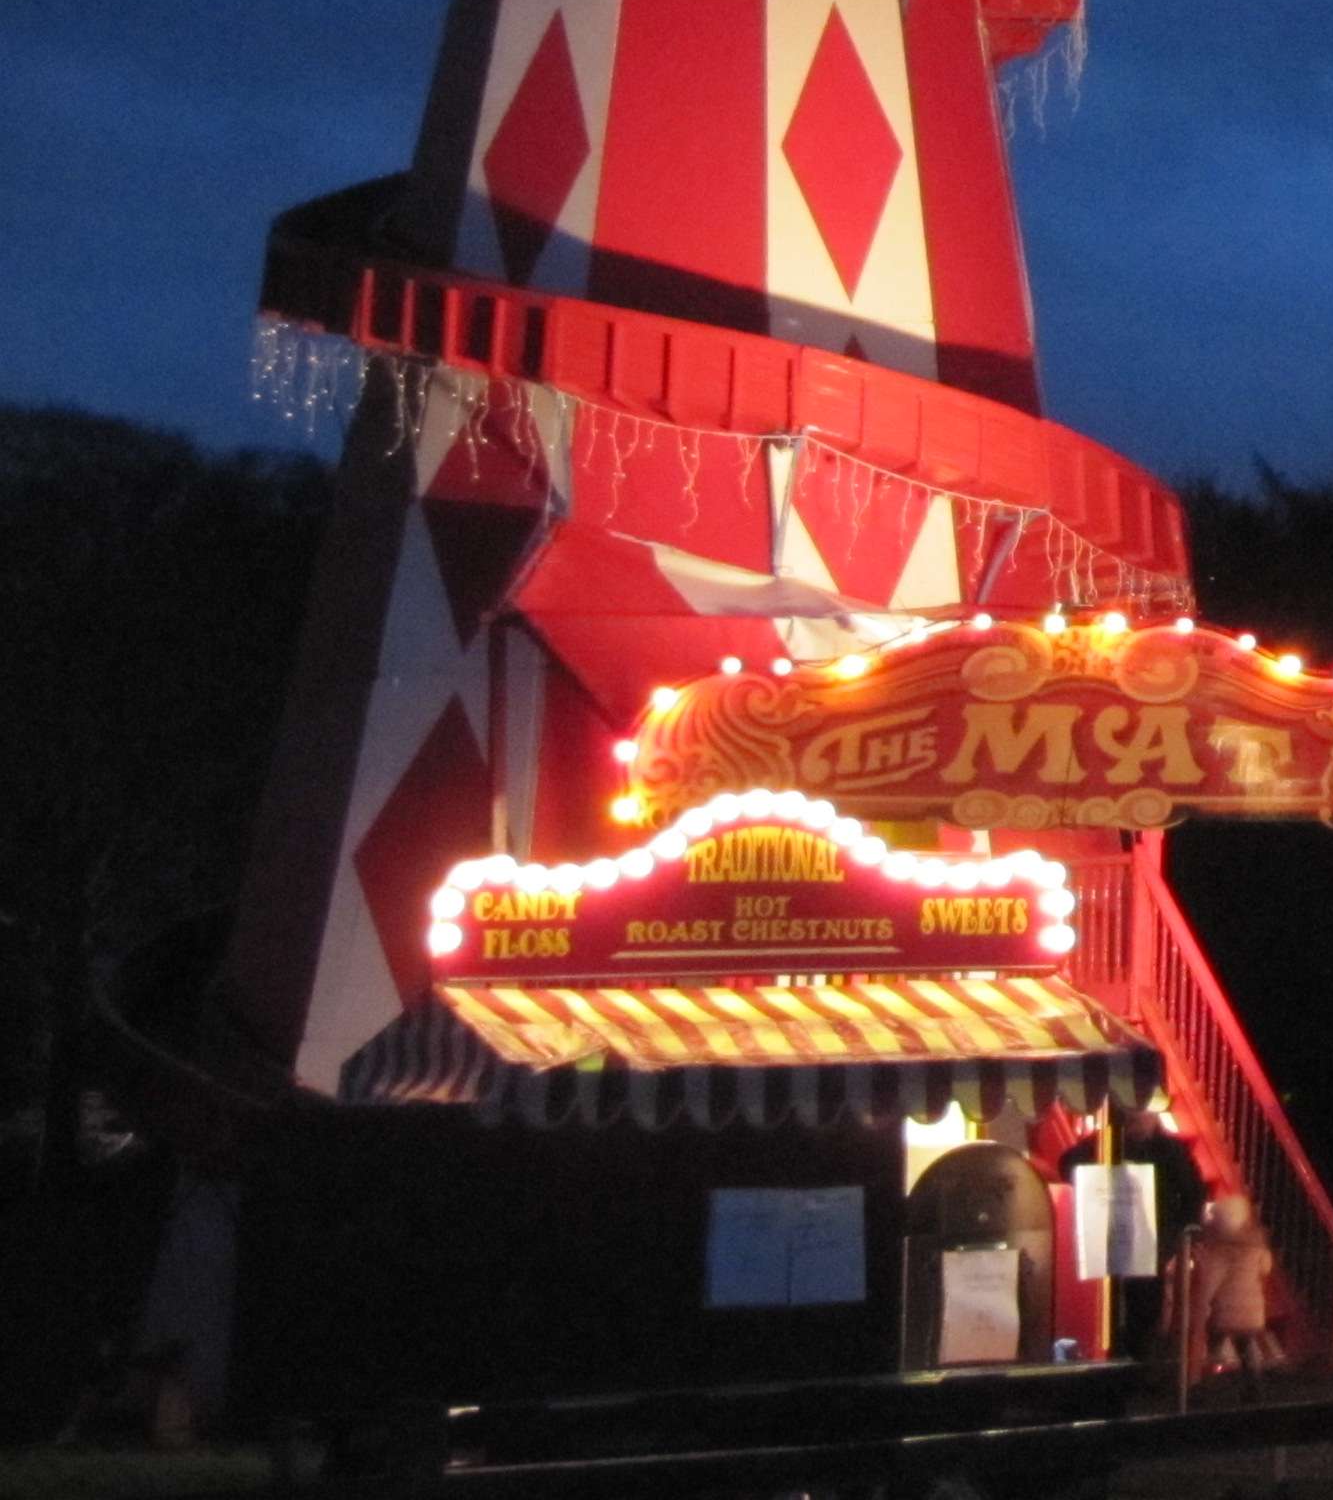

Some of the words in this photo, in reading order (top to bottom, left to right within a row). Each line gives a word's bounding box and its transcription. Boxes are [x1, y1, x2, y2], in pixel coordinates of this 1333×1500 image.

[801, 707, 938, 789] THE
[940, 703, 1293, 785] MAT
[683, 825, 845, 884] TRADITIONAL
[473, 890, 580, 922] CANDY
[735, 895, 791, 918] HOT
[920, 896, 1029, 935] SWEETS
[484, 927, 571, 960] FLOSS
[626, 920, 725, 944] ROAST
[732, 917, 894, 942] CHESTNUTS
